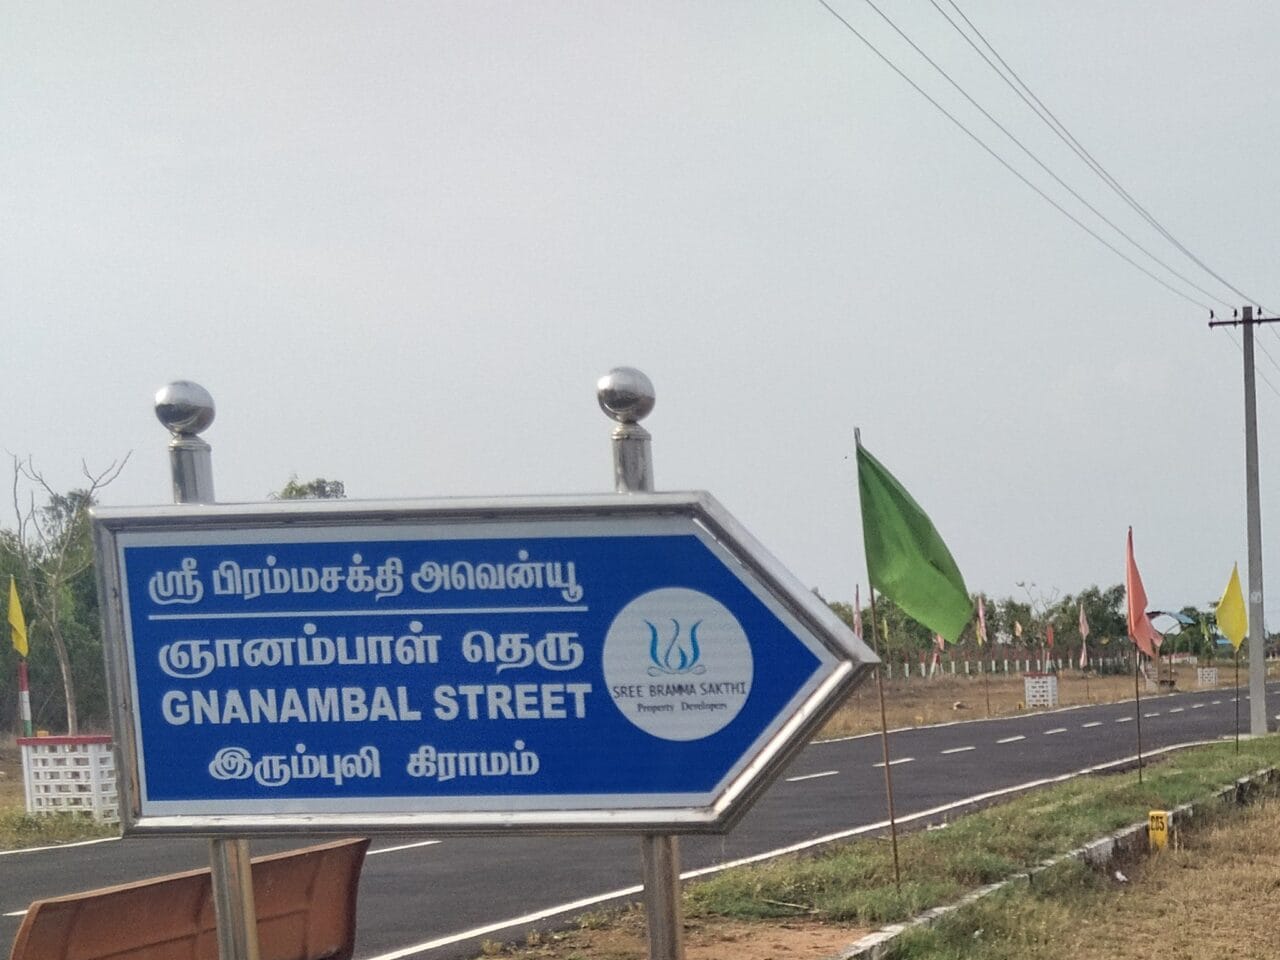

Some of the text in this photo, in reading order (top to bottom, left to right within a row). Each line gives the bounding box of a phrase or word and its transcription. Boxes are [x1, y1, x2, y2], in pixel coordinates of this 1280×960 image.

[212, 554, 404, 601] பிரம்மசக்தி
[411, 550, 584, 603] அவென்யூ
[159, 621, 584, 679] ஞானம்பாள் தெரு
[162, 684, 592, 726] GNANAMBAL STREET
[613, 684, 643, 699] SREE
[699, 681, 747, 696] SAKTHI
[637, 701, 727, 715] Property Developers
[208, 739, 539, 787] இரும்புலி கிராமம்
